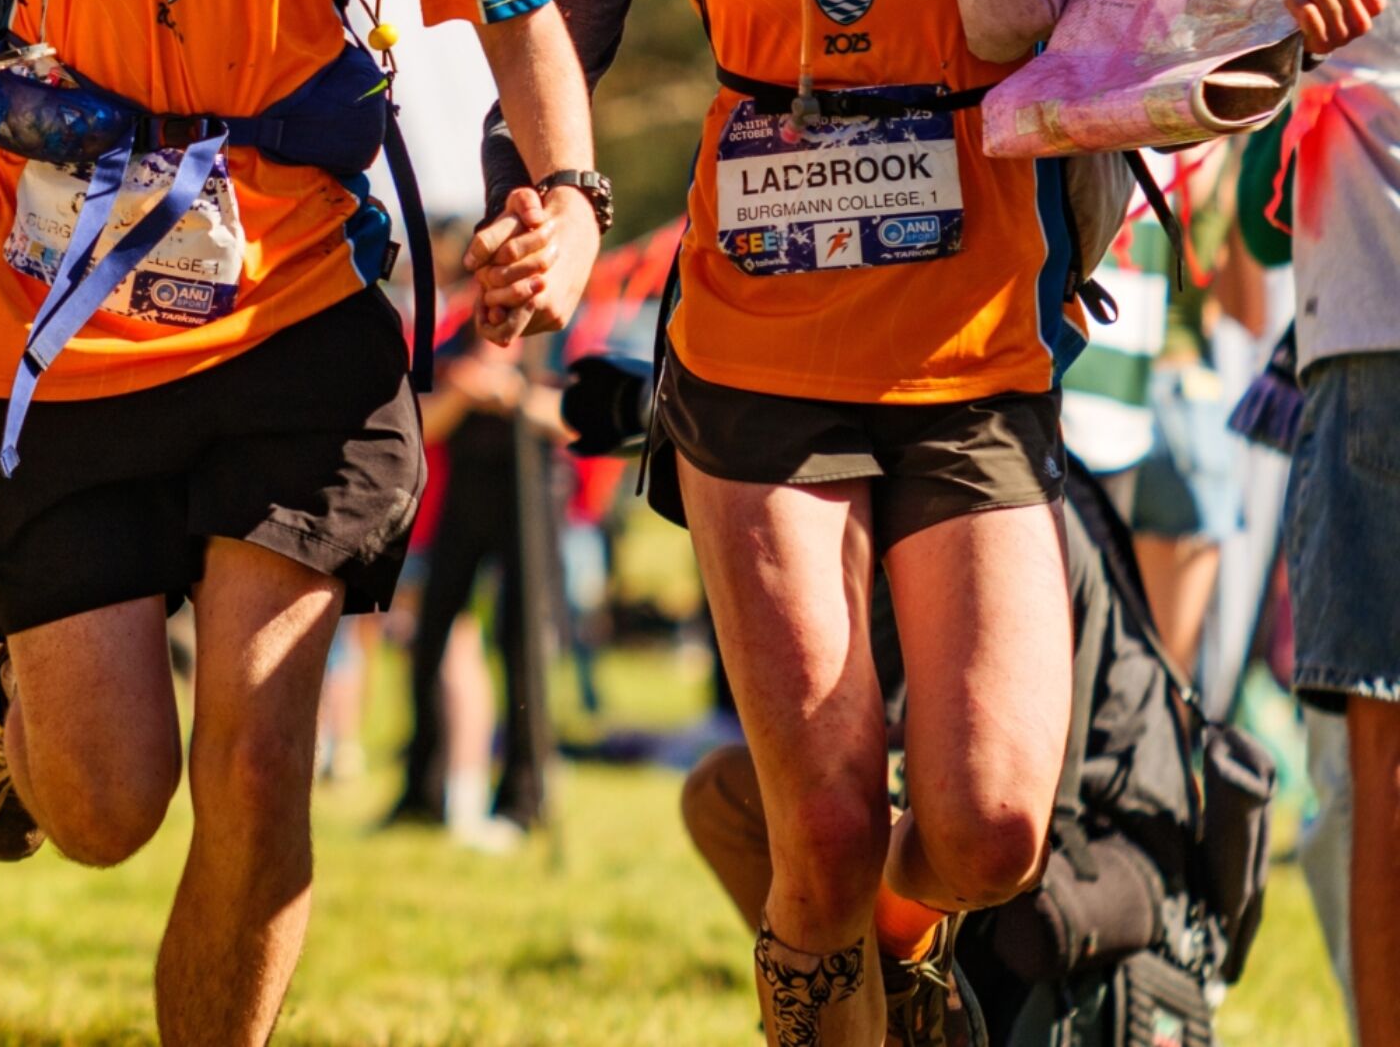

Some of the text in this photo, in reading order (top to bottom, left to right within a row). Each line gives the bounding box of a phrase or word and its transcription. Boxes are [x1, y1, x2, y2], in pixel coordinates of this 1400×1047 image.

[823, 33, 871, 55] 2025
[732, 120, 768, 132] 10-11TH
[729, 128, 774, 142] OCTOBER
[741, 153, 932, 196] LADBROOK
[737, 190, 938, 222] BURGMANN COLLEGE, 1
[906, 220, 936, 233] ANU
[906, 232, 936, 242] SPORT
[178, 285, 210, 302] ANU
[176, 299, 208, 310] SPORT
